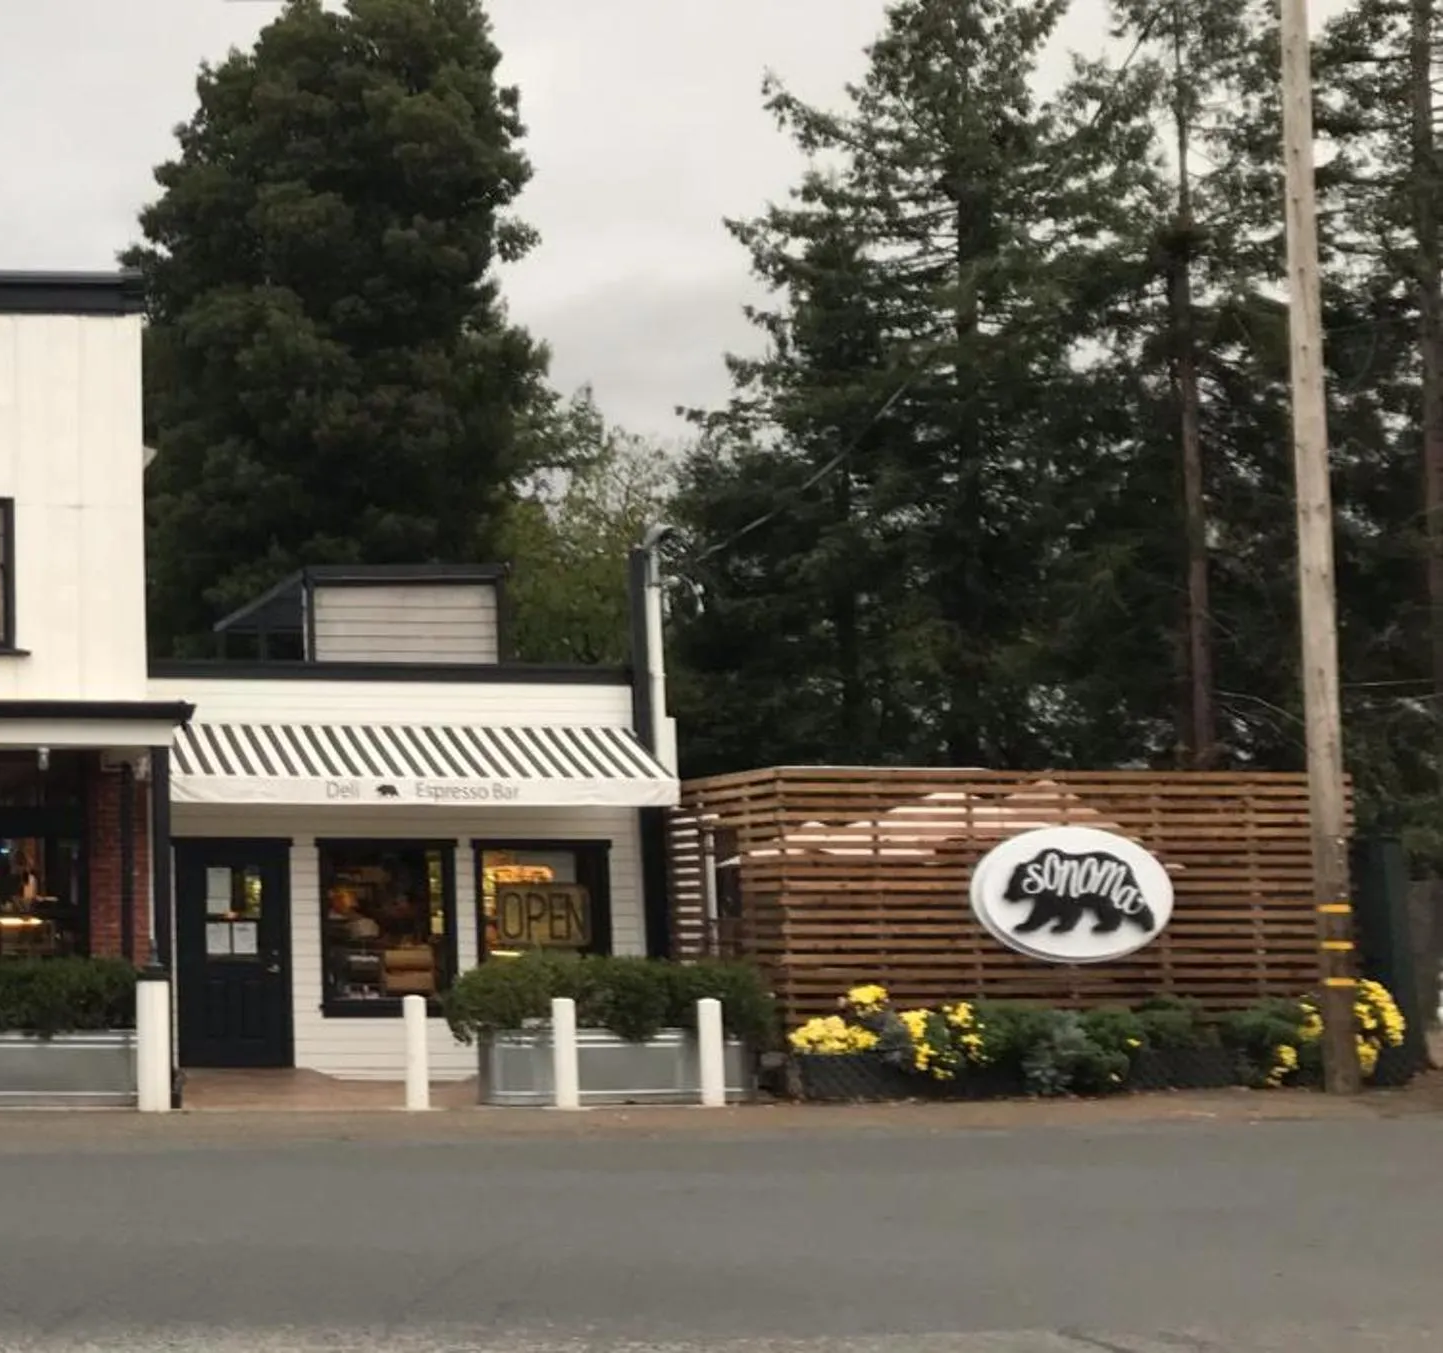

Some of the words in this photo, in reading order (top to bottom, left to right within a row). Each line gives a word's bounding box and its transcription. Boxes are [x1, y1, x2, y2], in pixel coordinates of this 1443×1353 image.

[325, 781, 360, 799] Deli
[415, 782, 490, 803] Espresso
[493, 783, 519, 800] Bar
[1021, 852, 1145, 915] sonoma
[502, 892, 588, 941] OPEN
